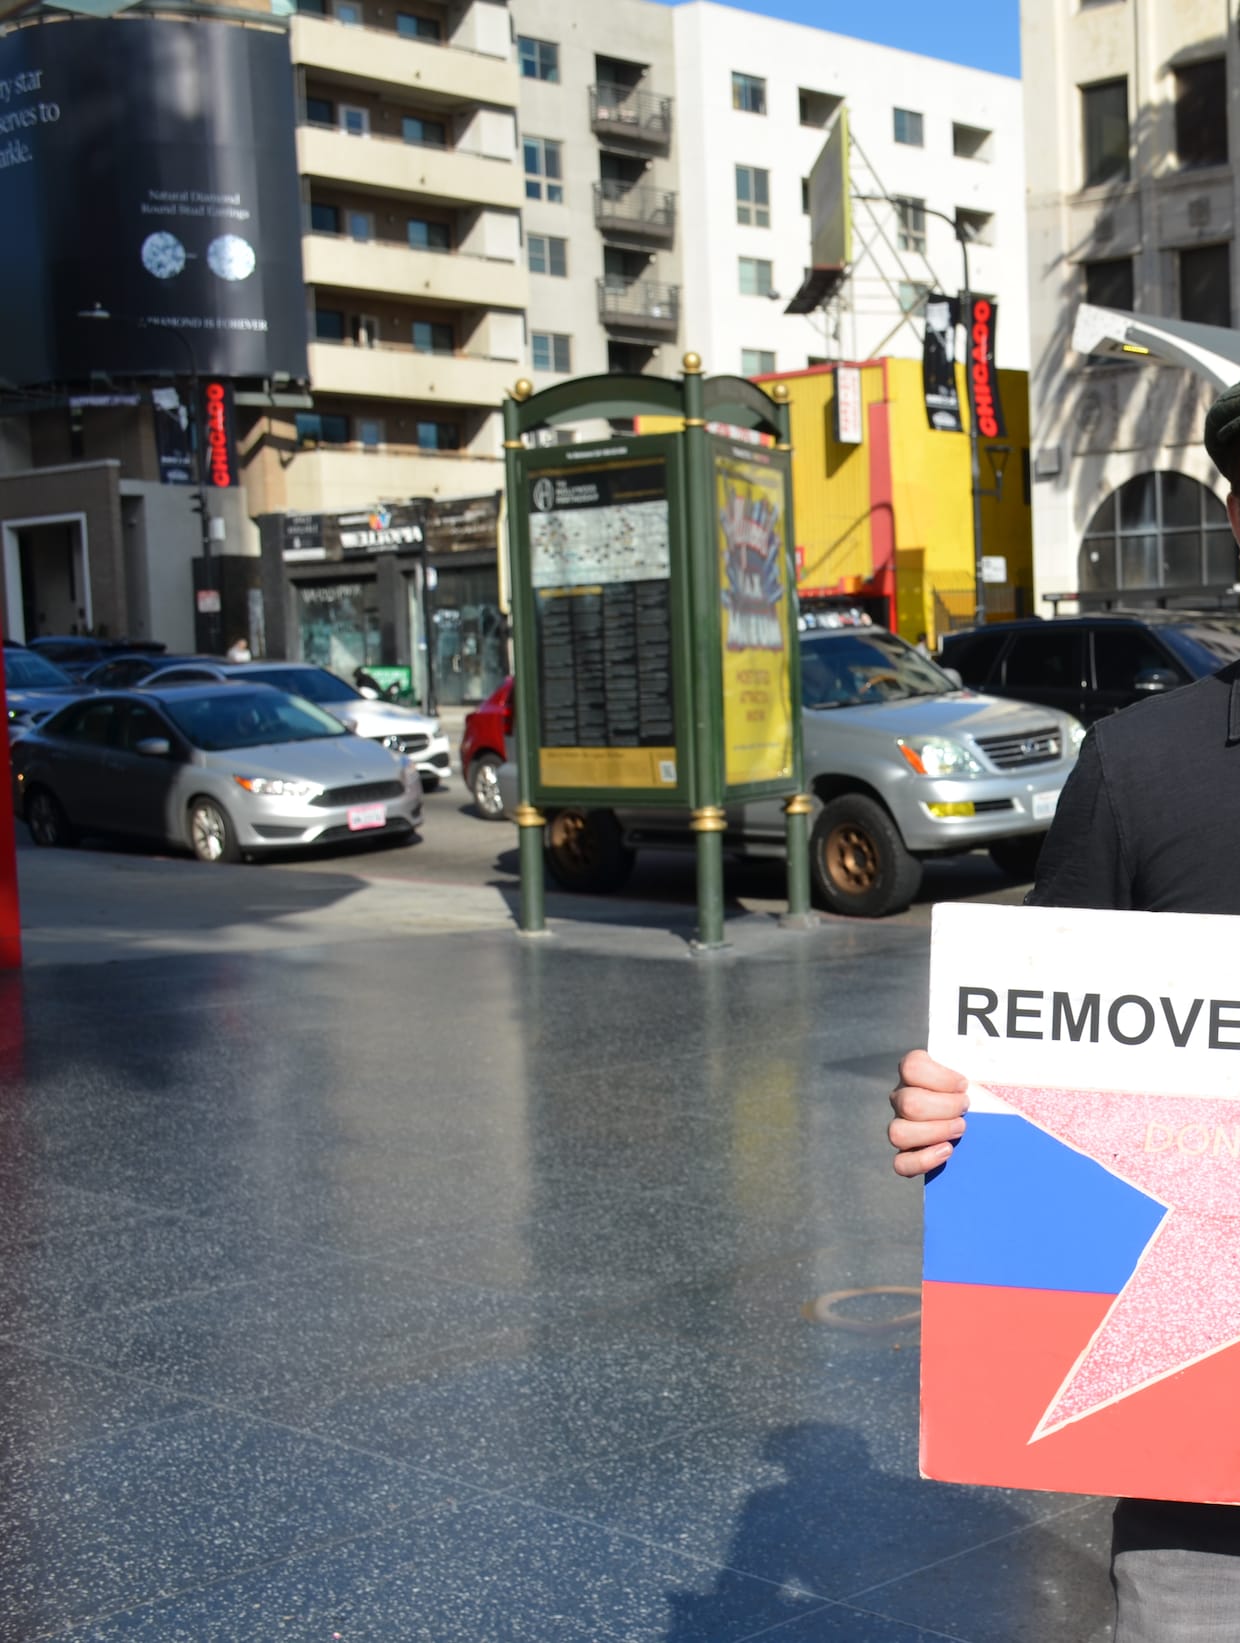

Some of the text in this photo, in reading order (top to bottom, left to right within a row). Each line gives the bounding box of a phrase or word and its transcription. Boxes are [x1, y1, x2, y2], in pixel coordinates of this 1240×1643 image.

[15, 70, 43, 95] star
[38, 101, 61, 123] to
[972, 300, 999, 438] CHICAGO
[206, 383, 231, 488] CHICAGO
